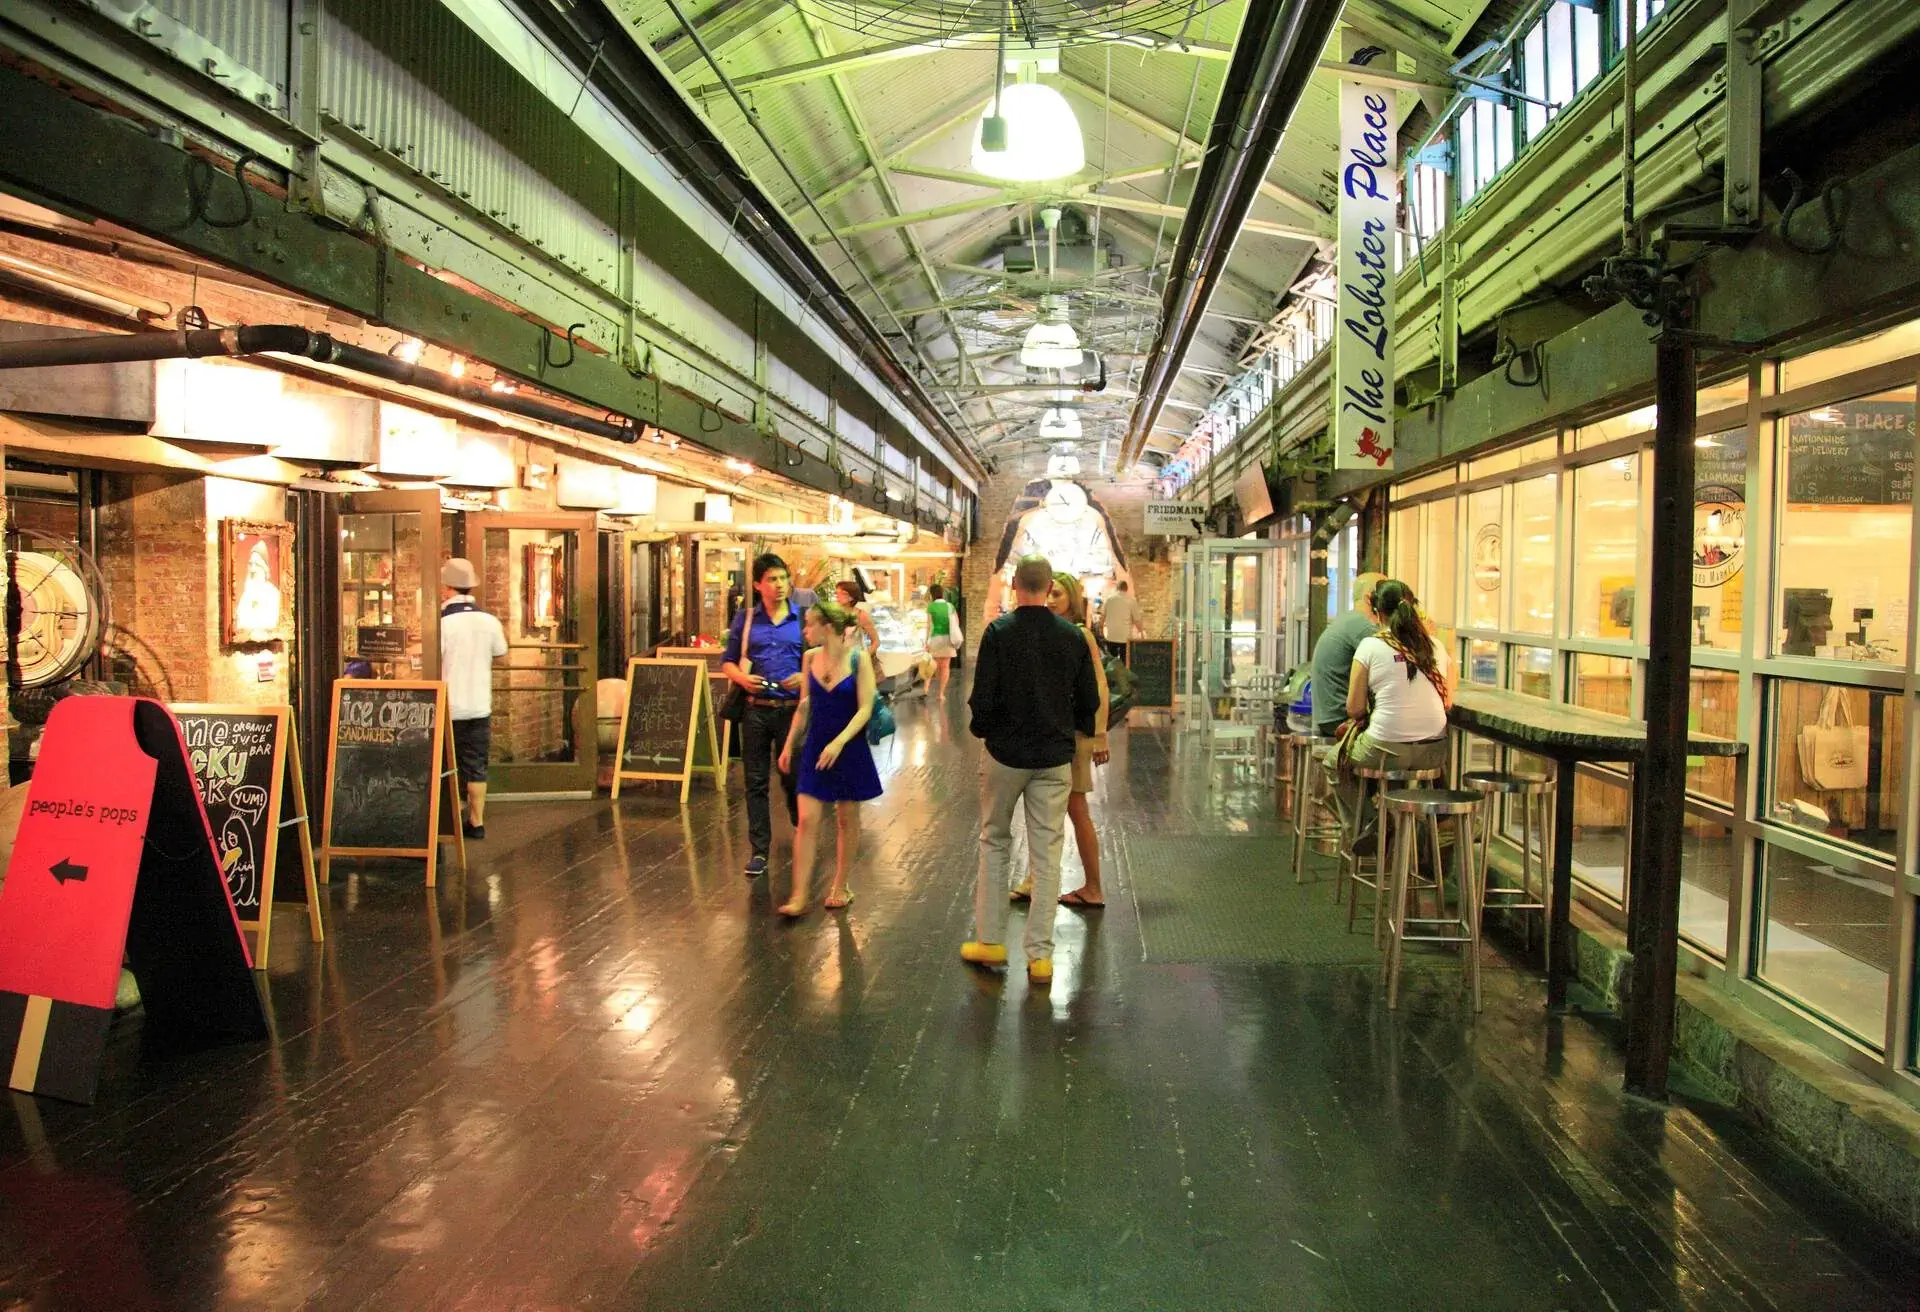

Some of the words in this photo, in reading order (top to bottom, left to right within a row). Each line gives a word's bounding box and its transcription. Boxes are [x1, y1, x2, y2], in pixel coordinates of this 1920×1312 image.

[1344, 94, 1389, 201] Place
[1344, 217, 1388, 361] Lobster
[1343, 368, 1386, 424] The
[1855, 413, 1905, 430] PLACE
[232, 722, 272, 734] ORGANIC
[231, 734, 266, 746] JUICE
[249, 745, 271, 757] BAR
[234, 791, 264, 806] YUM!
[29, 799, 95, 819] people's
[98, 806, 138, 825] pops
